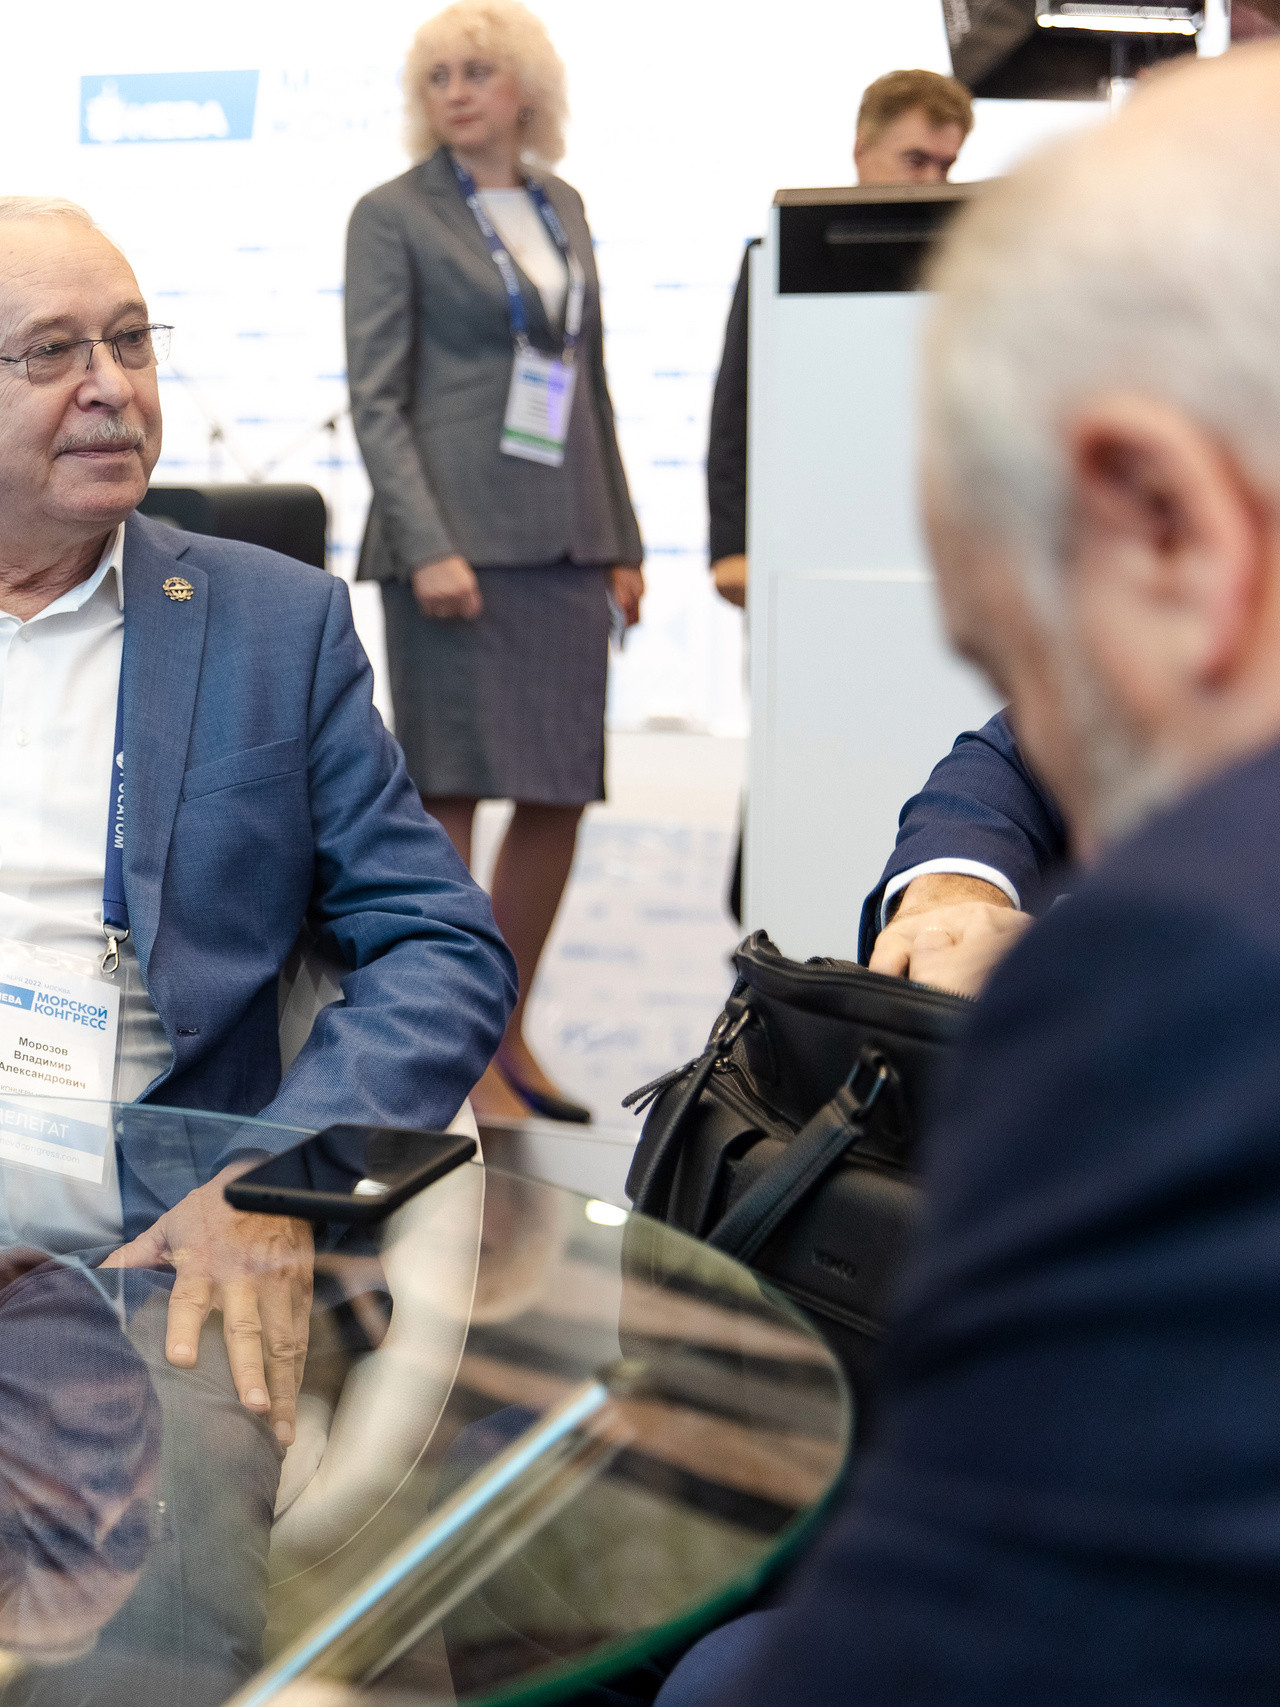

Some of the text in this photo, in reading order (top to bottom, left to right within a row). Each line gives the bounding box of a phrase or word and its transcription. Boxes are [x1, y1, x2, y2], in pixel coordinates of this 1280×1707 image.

[33, 1002, 107, 1031] КОНГРЕСС
[36, 991, 108, 1019] МОРСКОЙ
[18, 1036, 69, 1056] Морозов
[13, 1050, 72, 1072] Владимир
